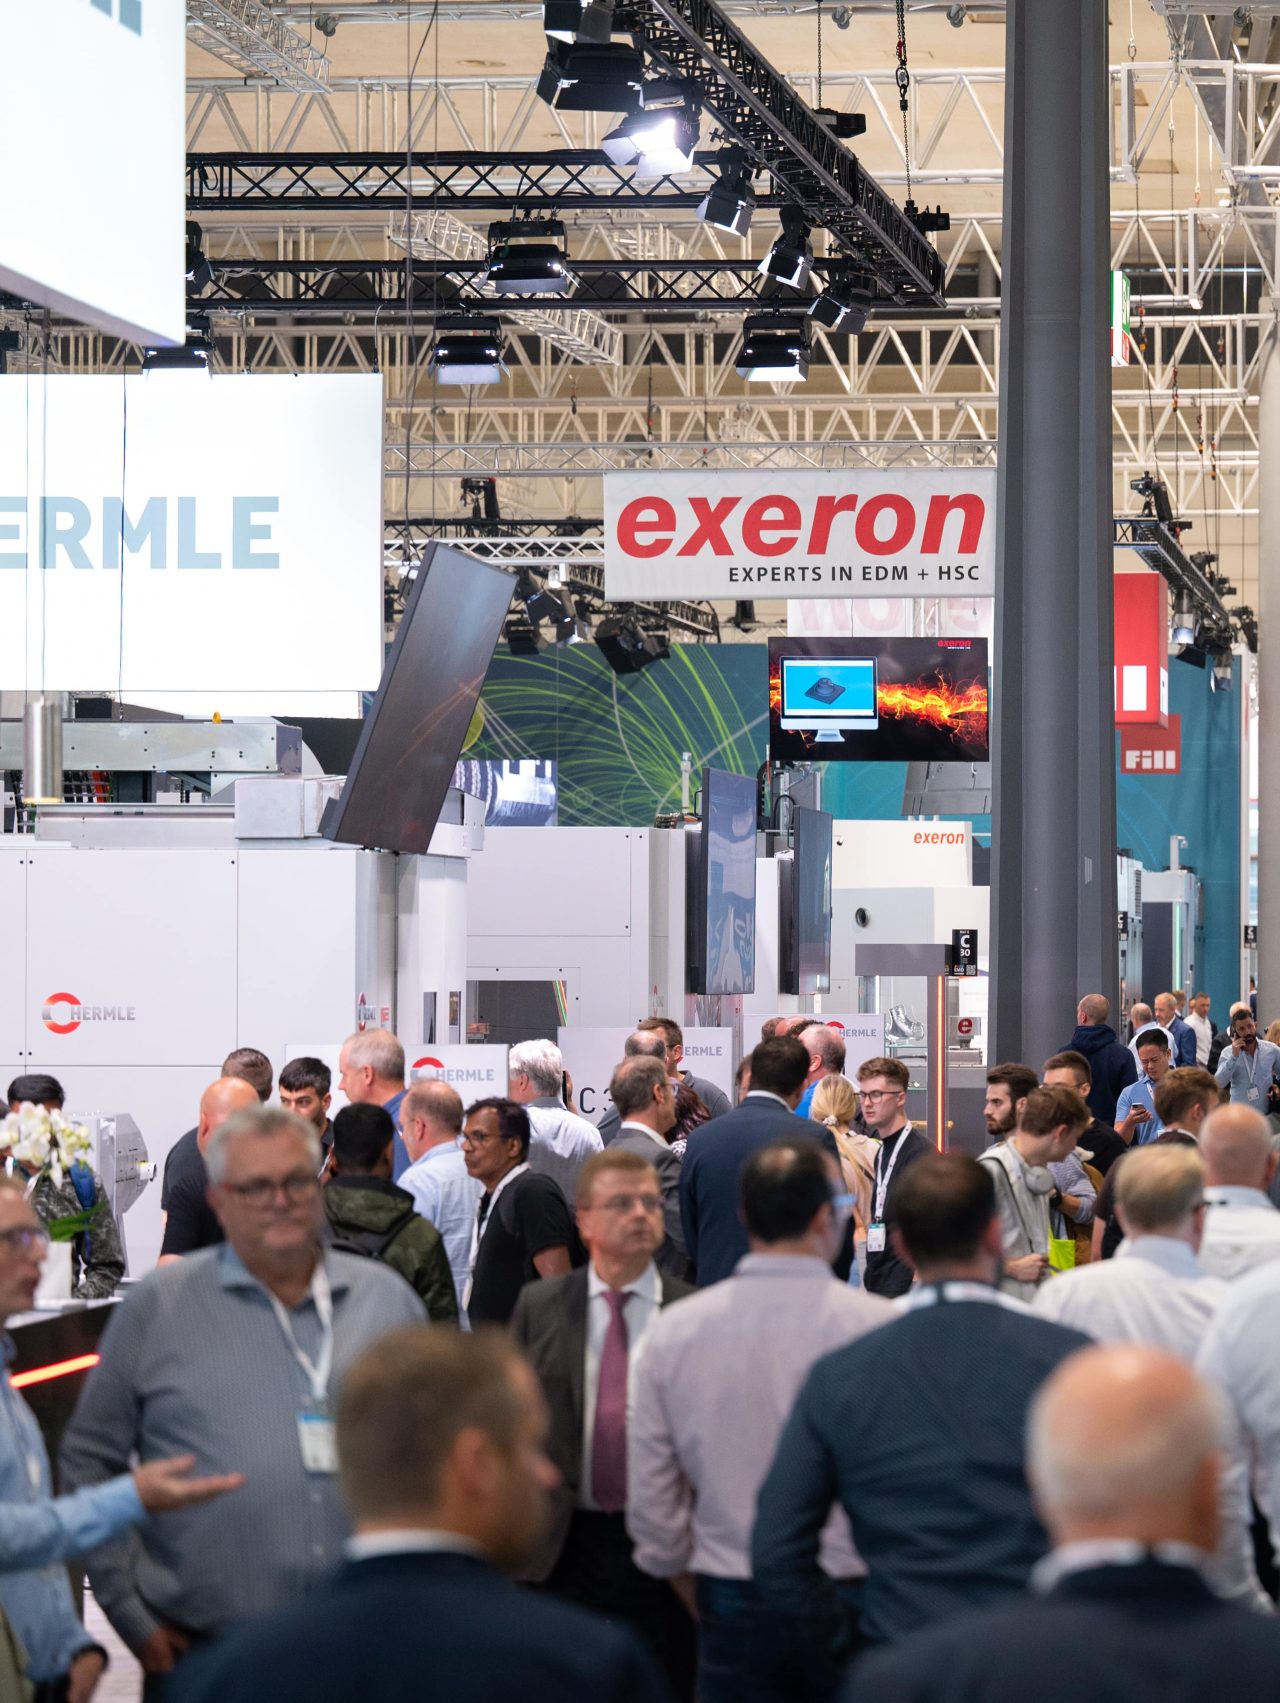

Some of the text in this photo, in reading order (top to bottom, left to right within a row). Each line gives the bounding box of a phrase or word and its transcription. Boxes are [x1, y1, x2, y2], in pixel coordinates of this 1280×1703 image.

[616, 493, 985, 559] exeron
[729, 566, 823, 582] EXPERTS
[831, 565, 852, 581] IN
[862, 565, 908, 581] EDM
[938, 565, 980, 581] HSC
[1125, 750, 1176, 769] Fill
[913, 832, 965, 845] exeron
[960, 934, 970, 948] C
[959, 948, 971, 957] 30
[70, 1006, 135, 1021] HERMLE
[839, 1028, 877, 1038] HERMLE
[684, 1046, 723, 1057] ERMLE
[435, 1068, 495, 1082] HERMLE
